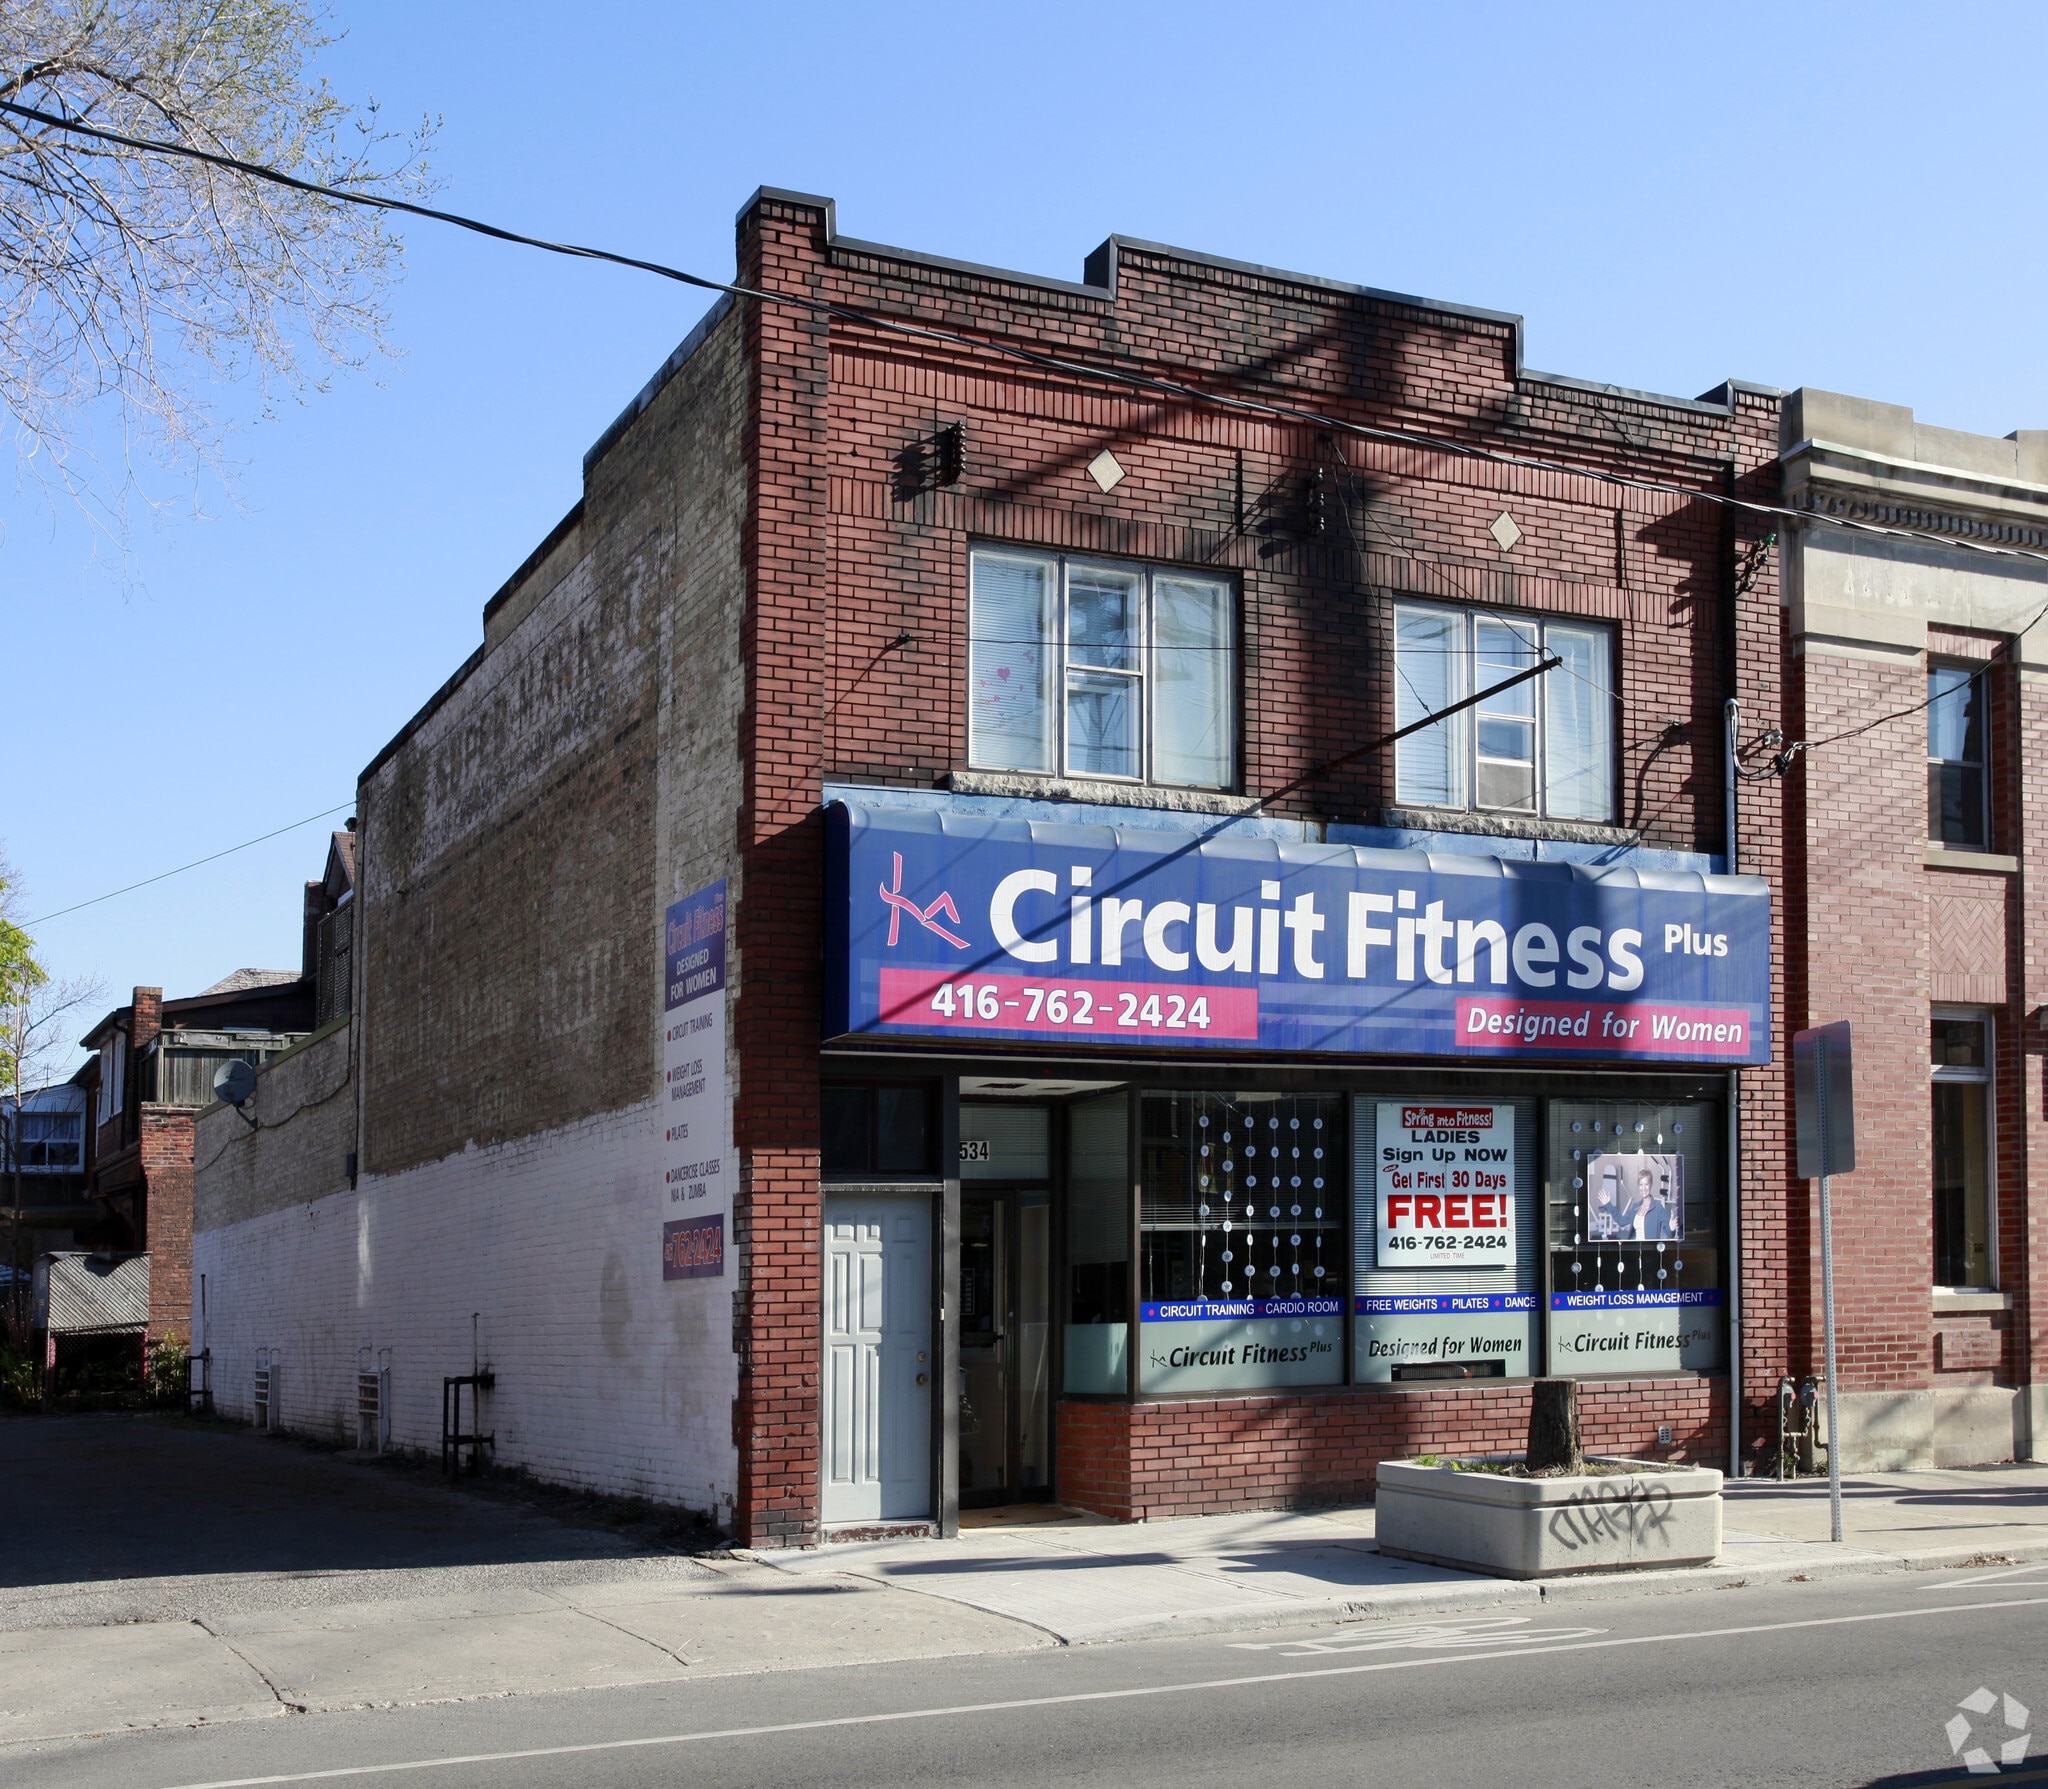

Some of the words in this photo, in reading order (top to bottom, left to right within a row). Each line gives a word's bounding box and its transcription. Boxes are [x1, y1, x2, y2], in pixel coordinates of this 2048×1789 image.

[990, 866, 1325, 979] Circuit
[1347, 889, 1645, 992] Fitness
[1664, 923, 1729, 957] Plus
[676, 947, 710, 977] DESIGNED
[670, 980, 684, 1002] FOR
[685, 966, 717, 995] WOMEN
[931, 982, 1211, 1030] 416-762-2424
[672, 1021, 689, 1041] CIRCUIT
[690, 1012, 713, 1034] TRAINING
[1467, 1006, 1591, 1043] Designed
[1601, 1011, 1640, 1039] for
[1651, 1014, 1743, 1044] Women
[672, 1063, 690, 1082] WEIGHT
[691, 1059, 703, 1076] LOSS
[671, 1077, 706, 1101] MANAGEMENT
[1437, 1116, 1456, 1127] into
[1456, 1110, 1492, 1127] Fitness!
[671, 1123, 689, 1141] PILATES
[1411, 1130, 1480, 1144] LADIES
[959, 1141, 989, 1160] 534
[1383, 1148, 1423, 1163] Sign
[1432, 1148, 1456, 1163] Up
[1464, 1148, 1508, 1162] NOW
[670, 1162, 699, 1184] DANCERCISE
[699, 1158, 721, 1178] CLASSES
[1392, 1171, 1412, 1189] Get
[1417, 1171, 1445, 1189] First
[1452, 1170, 1470, 1188] 30
[1475, 1170, 1507, 1190] Days
[688, 1183, 707, 1200] ZUMBA
[1387, 1194, 1508, 1229] FREE!
[1388, 1235, 1508, 1250] 416-762-2424
[1430, 1252, 1451, 1260] LIMITED
[1160, 1304, 1204, 1318] CIRCUIT
[1205, 1303, 1255, 1316] TRAINING
[1265, 1302, 1306, 1315] CARDIO
[1307, 1301, 1339, 1313] ROOM
[1366, 1300, 1392, 1311] FREE
[1394, 1298, 1438, 1311] WEIGHTS
[1452, 1297, 1489, 1309] PILATES
[1505, 1296, 1536, 1308] DANCE
[1567, 1294, 1607, 1306] WEIGHT
[1608, 1293, 1635, 1306] LOSS
[1636, 1292, 1704, 1304] MANAGEMENT
[1368, 1337, 1438, 1361] Designed
[1442, 1336, 1465, 1358] for
[1470, 1336, 1522, 1353] Women
[1574, 1331, 1629, 1353] Circuit
[1635, 1331, 1691, 1350] Fitness
[1692, 1329, 1712, 1341] Plus
[1169, 1346, 1236, 1368] Circuit
[1242, 1343, 1308, 1364] Fitness
[1310, 1341, 1333, 1353] Plus
